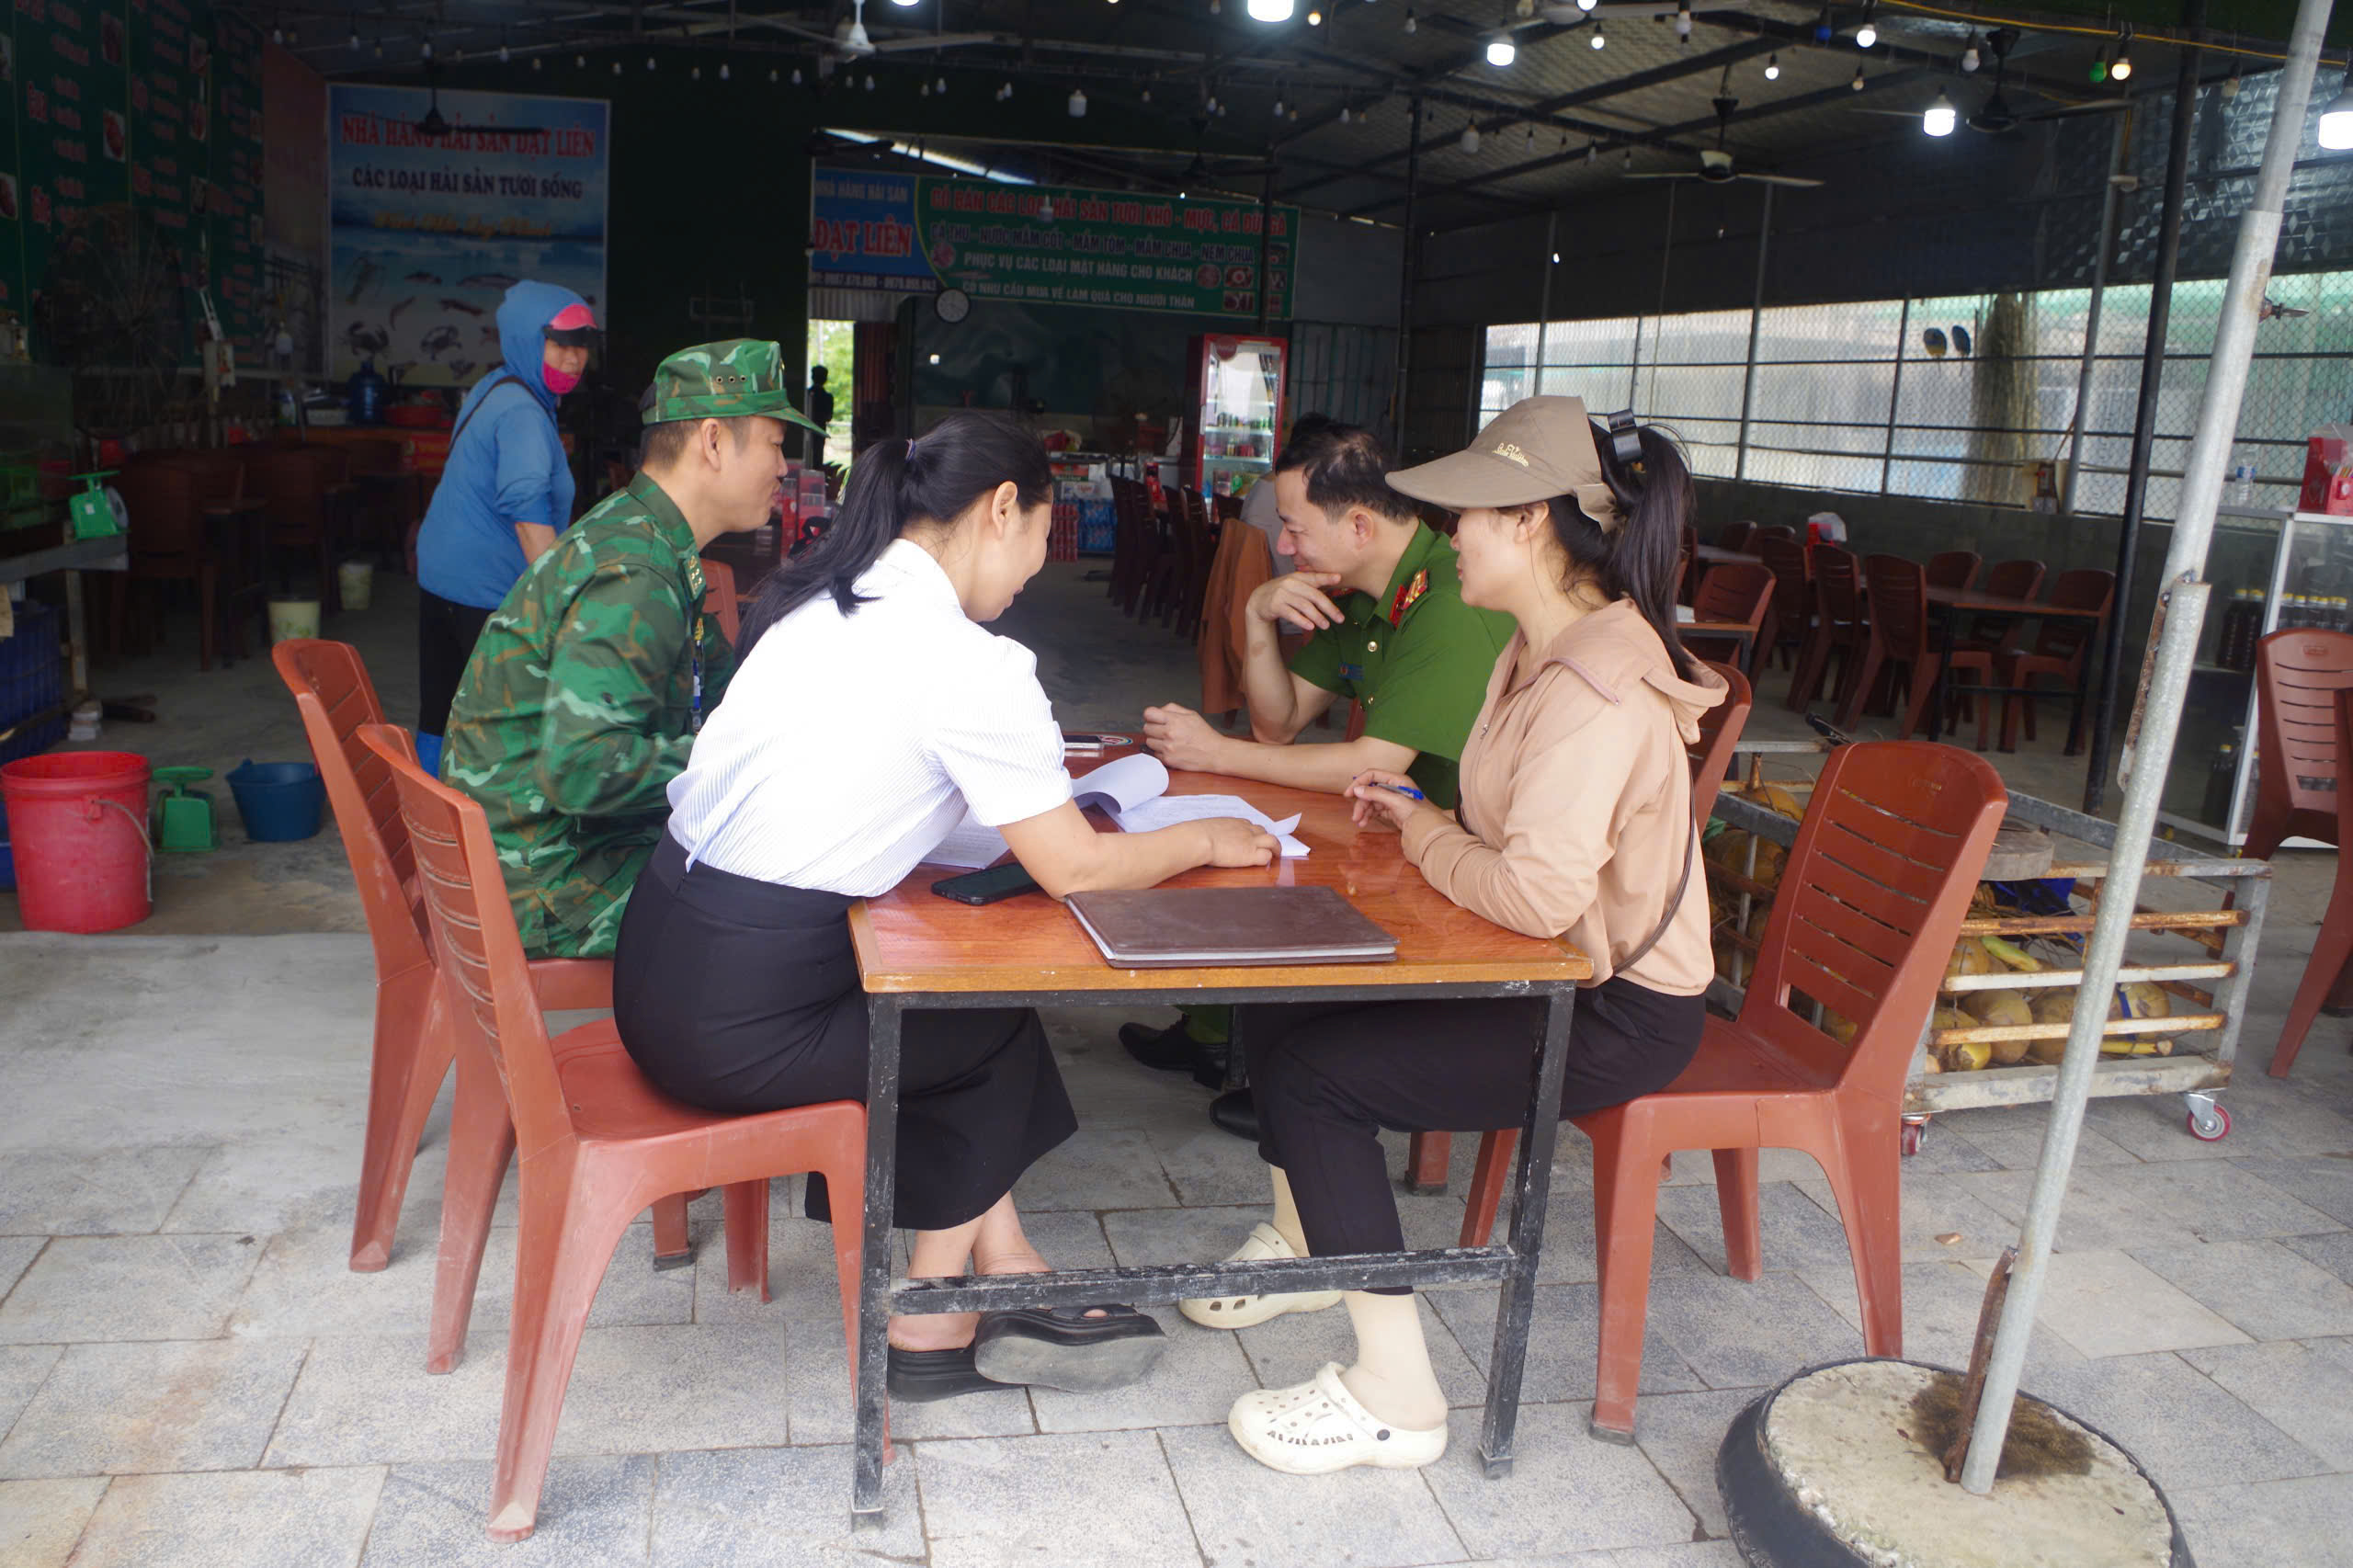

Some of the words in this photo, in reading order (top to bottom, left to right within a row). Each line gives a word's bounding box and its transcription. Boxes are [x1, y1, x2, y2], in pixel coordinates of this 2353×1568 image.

[342, 110, 379, 145] NHÀ
[555, 119, 596, 158] LIÊN
[352, 164, 384, 187] CÁC
[389, 169, 426, 195] LOẠI
[430, 165, 459, 192] HẢI
[462, 166, 494, 194] SẢN
[499, 176, 536, 198] TƯƠI
[540, 171, 583, 199] SỐNG
[954, 187, 984, 211] BÁN
[987, 188, 1016, 213] CÁC
[1079, 195, 1108, 221] SẢN
[863, 213, 913, 258] LIÊN
[964, 251, 995, 272] PHỤC
[998, 254, 1014, 272] VỤ
[1016, 253, 1040, 271] CÁC
[1042, 258, 1067, 278] LOẠI
[1097, 261, 1127, 278] HÀNG
[1130, 264, 1154, 279] CHO
[1155, 263, 1193, 283] KHÁCH
[1026, 285, 1049, 298] MUA
[1113, 291, 1134, 305] CHO
